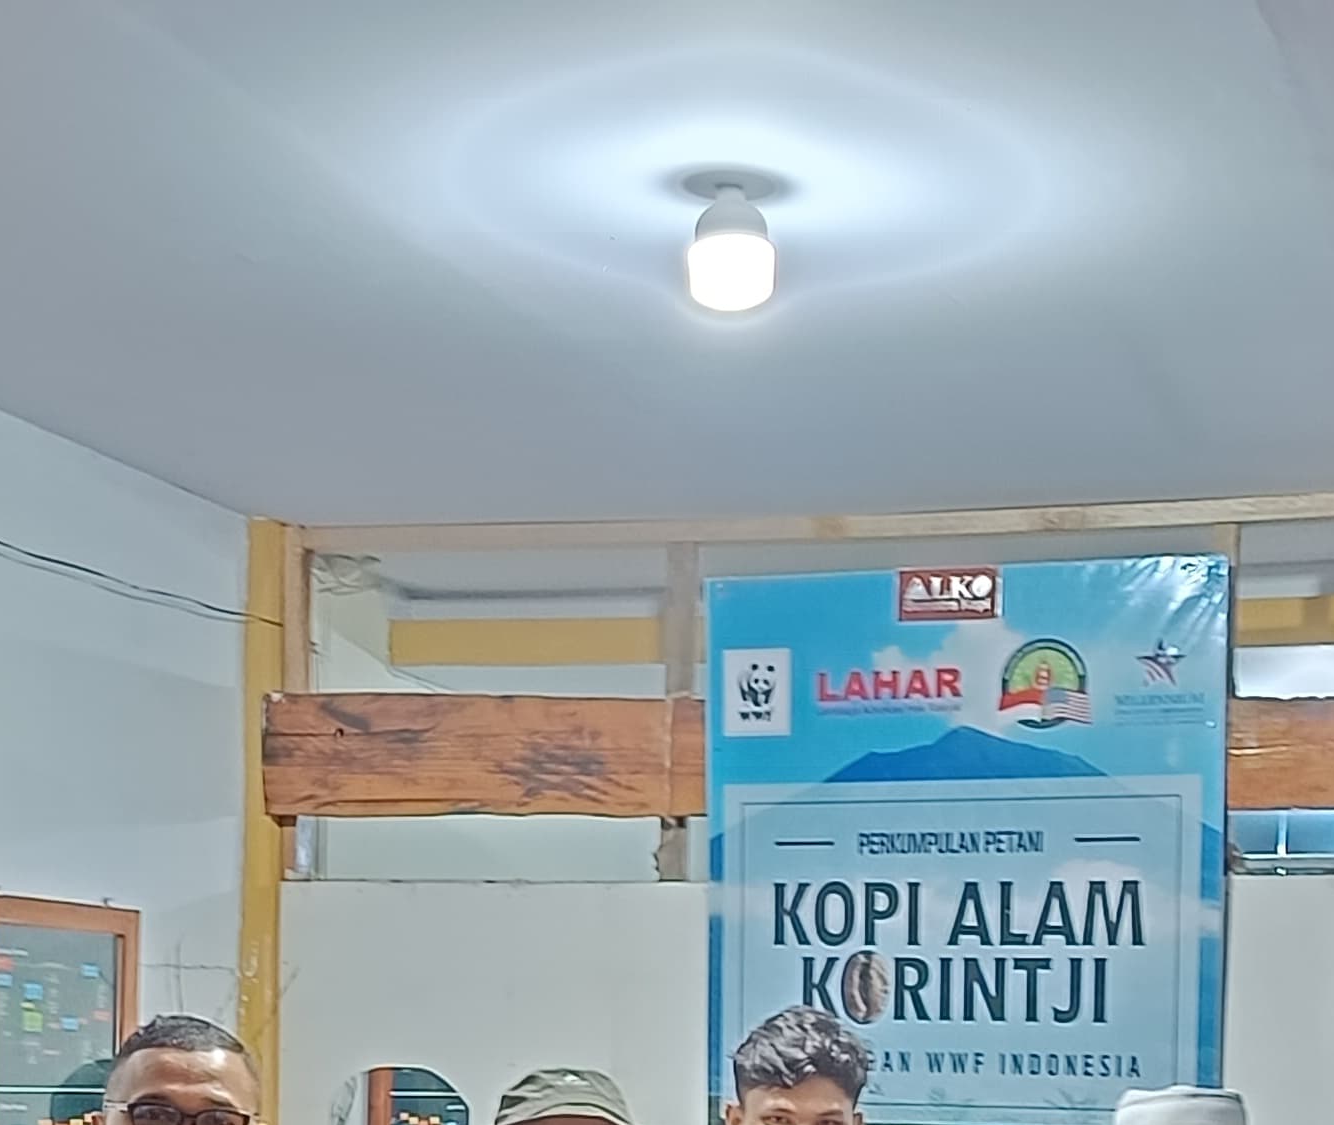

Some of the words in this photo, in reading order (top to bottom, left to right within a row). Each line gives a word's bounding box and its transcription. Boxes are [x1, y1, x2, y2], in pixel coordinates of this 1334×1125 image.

[903, 575, 993, 600] ALKO
[818, 668, 963, 702] LAHAR
[858, 832, 980, 855] PERKUMPULAN
[984, 831, 1044, 853] PETANI
[772, 881, 921, 947] KOPI
[947, 880, 1146, 947] ALAM
[801, 951, 1108, 1024] KORINTJI
[927, 1052, 986, 1075] WWF
[999, 1053, 1142, 1078] INDONESIA
